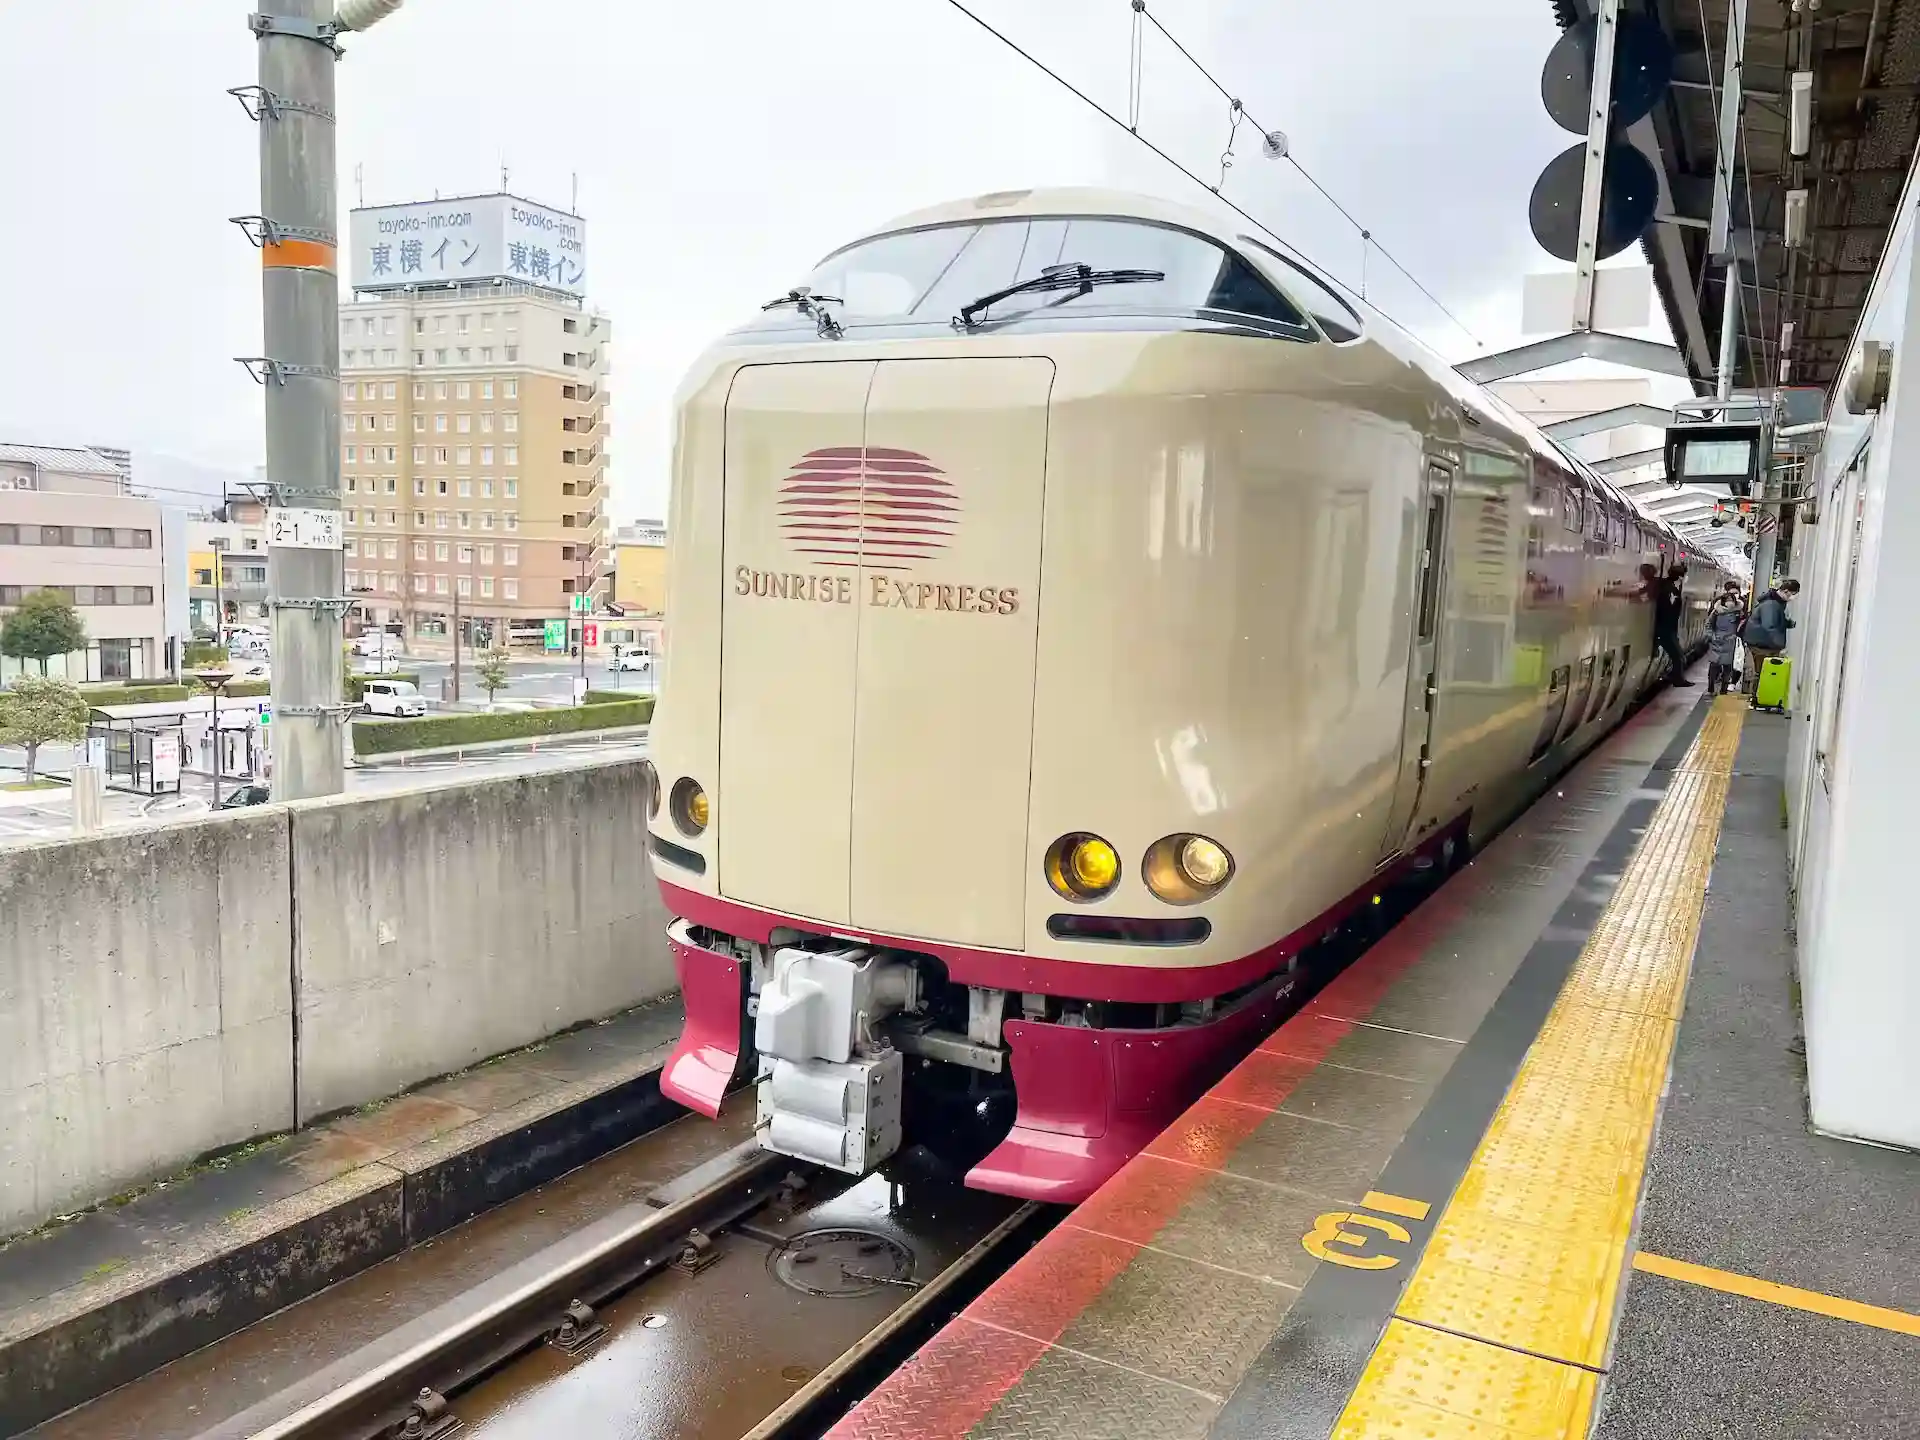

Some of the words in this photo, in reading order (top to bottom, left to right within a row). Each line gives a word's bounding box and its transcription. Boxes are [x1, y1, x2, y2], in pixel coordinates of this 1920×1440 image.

[378, 211, 472, 235] toyoko-inn.com
[510, 205, 577, 238] toyoko-inn
[370, 236, 480, 276] 東横イン
[507, 240, 585, 285] 東横イン
[735, 564, 852, 604] SUNRISE
[869, 574, 1021, 616] EXPRESS
